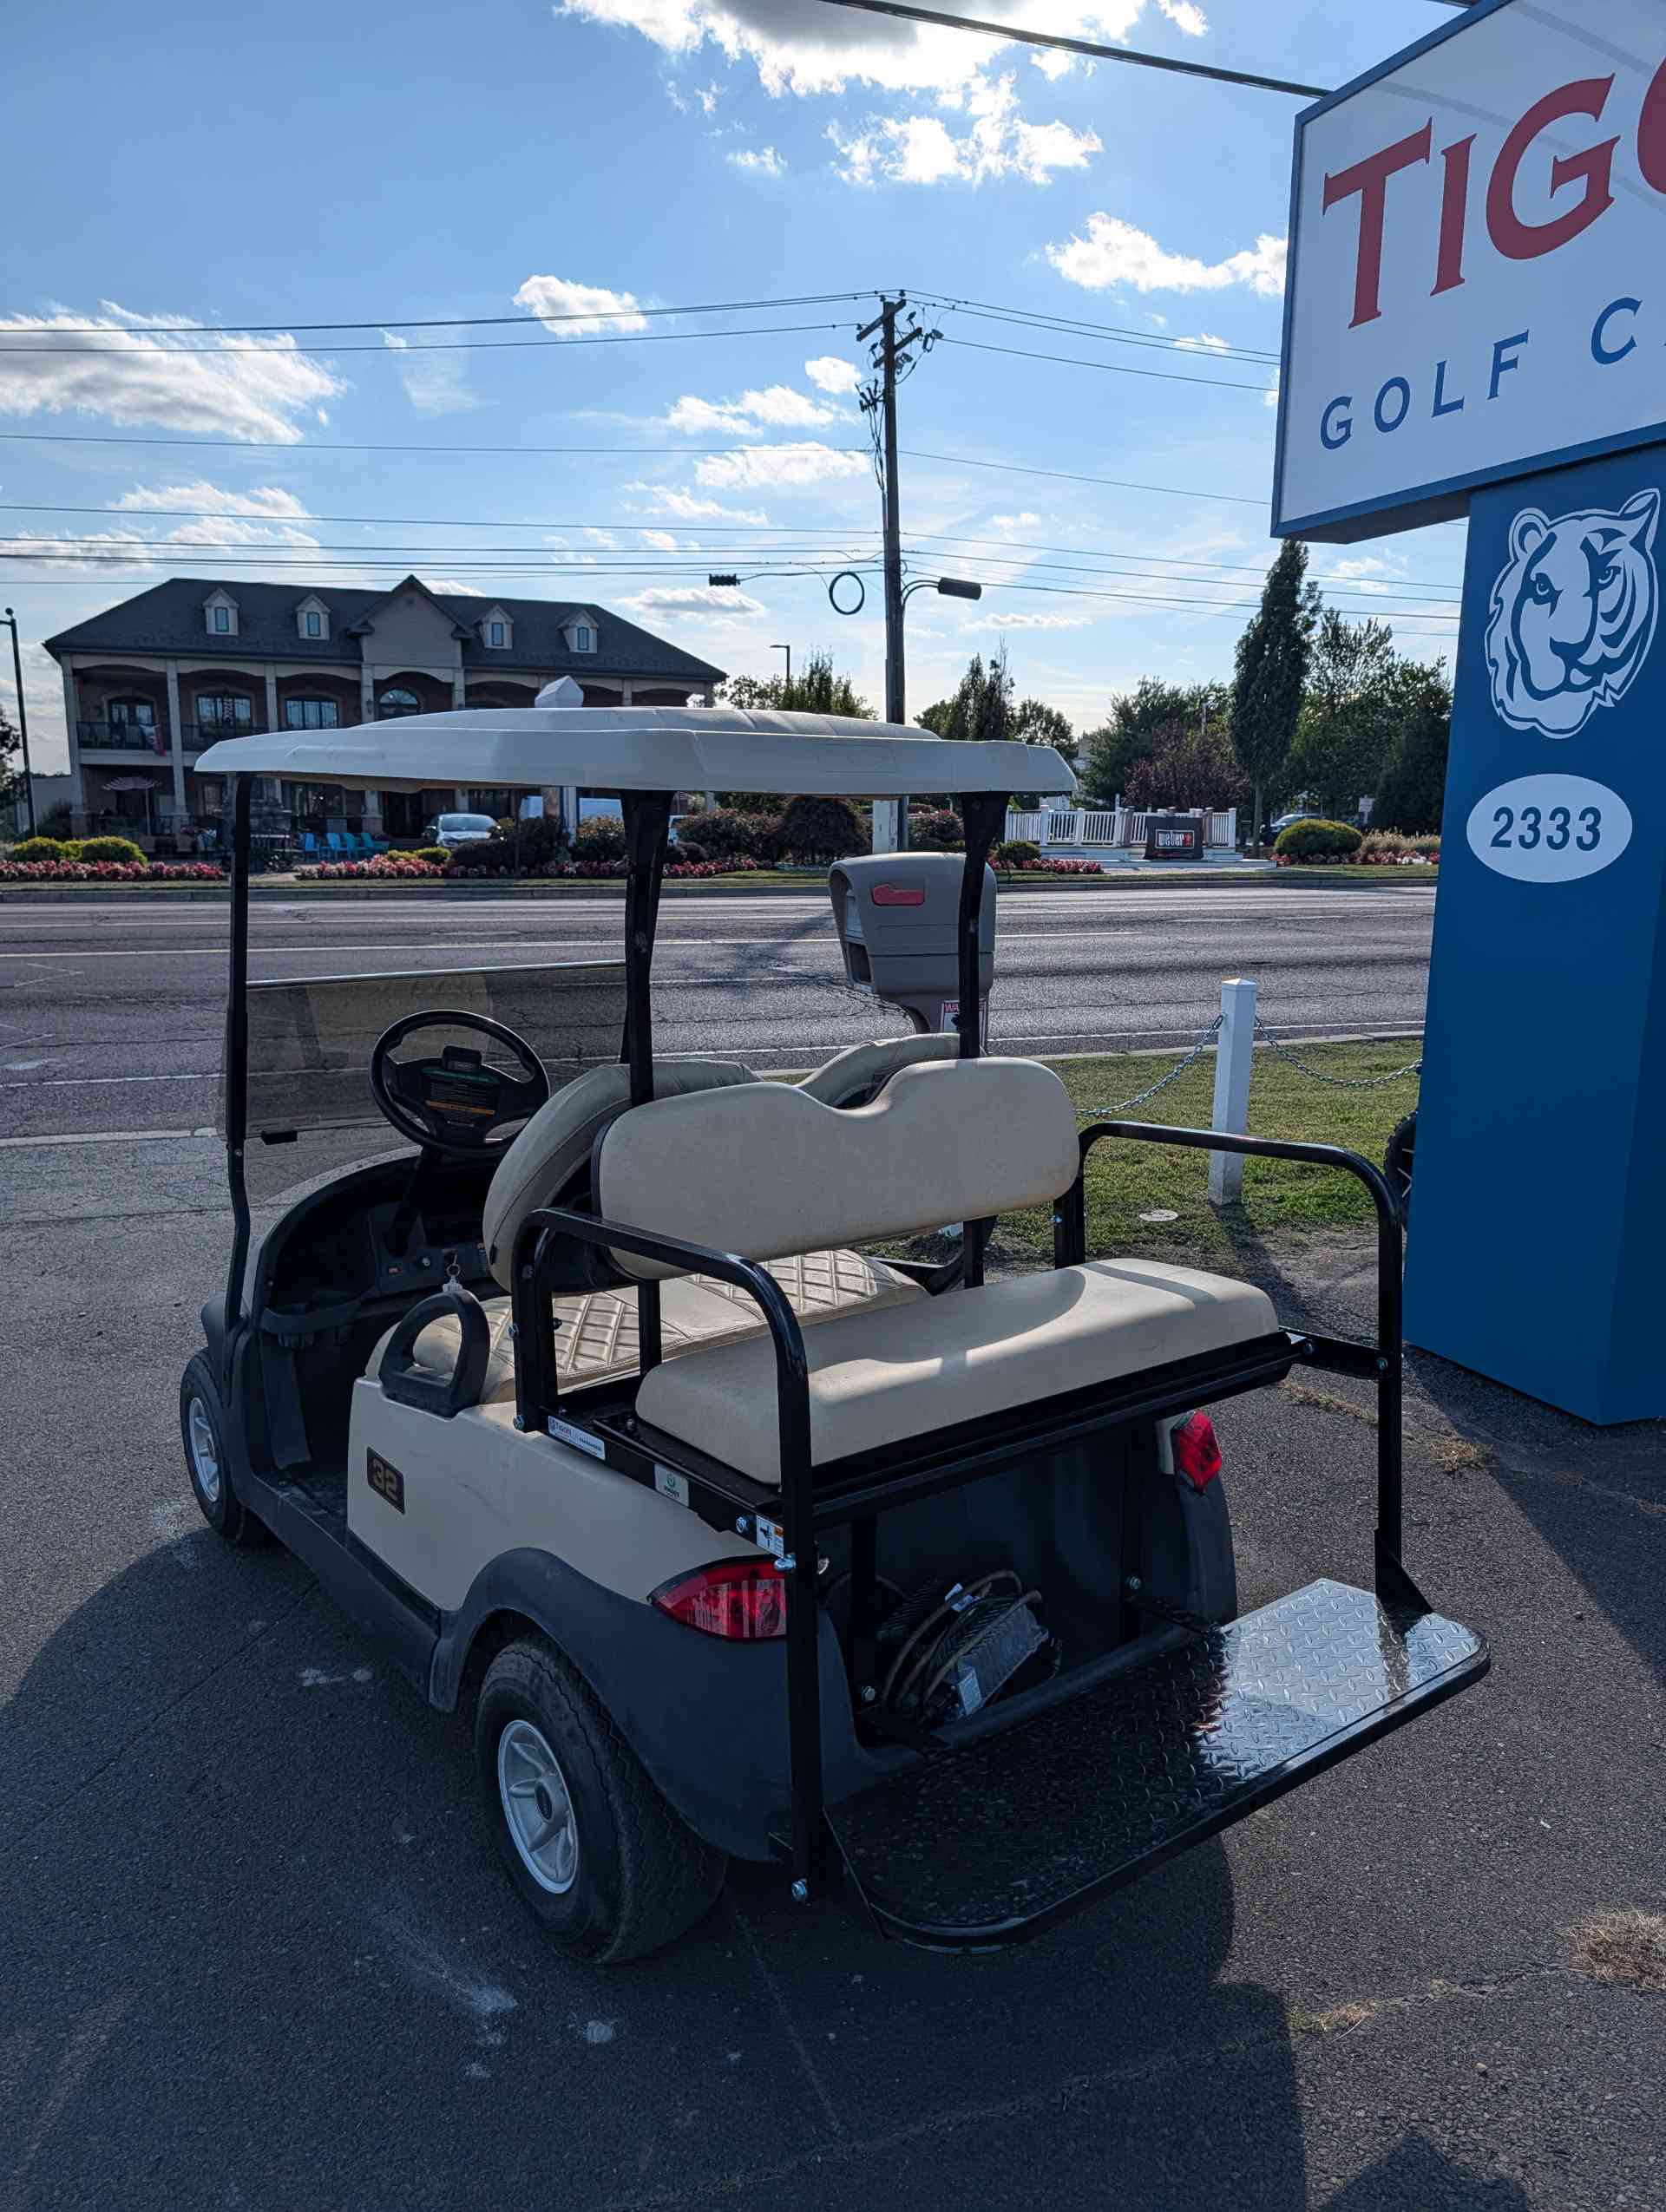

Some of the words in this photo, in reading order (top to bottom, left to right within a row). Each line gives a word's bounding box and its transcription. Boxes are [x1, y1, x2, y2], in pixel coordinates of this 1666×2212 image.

[1322, 56, 1666, 329] TIG
[1320, 329, 1529, 450] GOLF
[1591, 298, 1666, 365] C
[1490, 806, 1601, 851] 2333
[372, 1457, 397, 1501] 32
